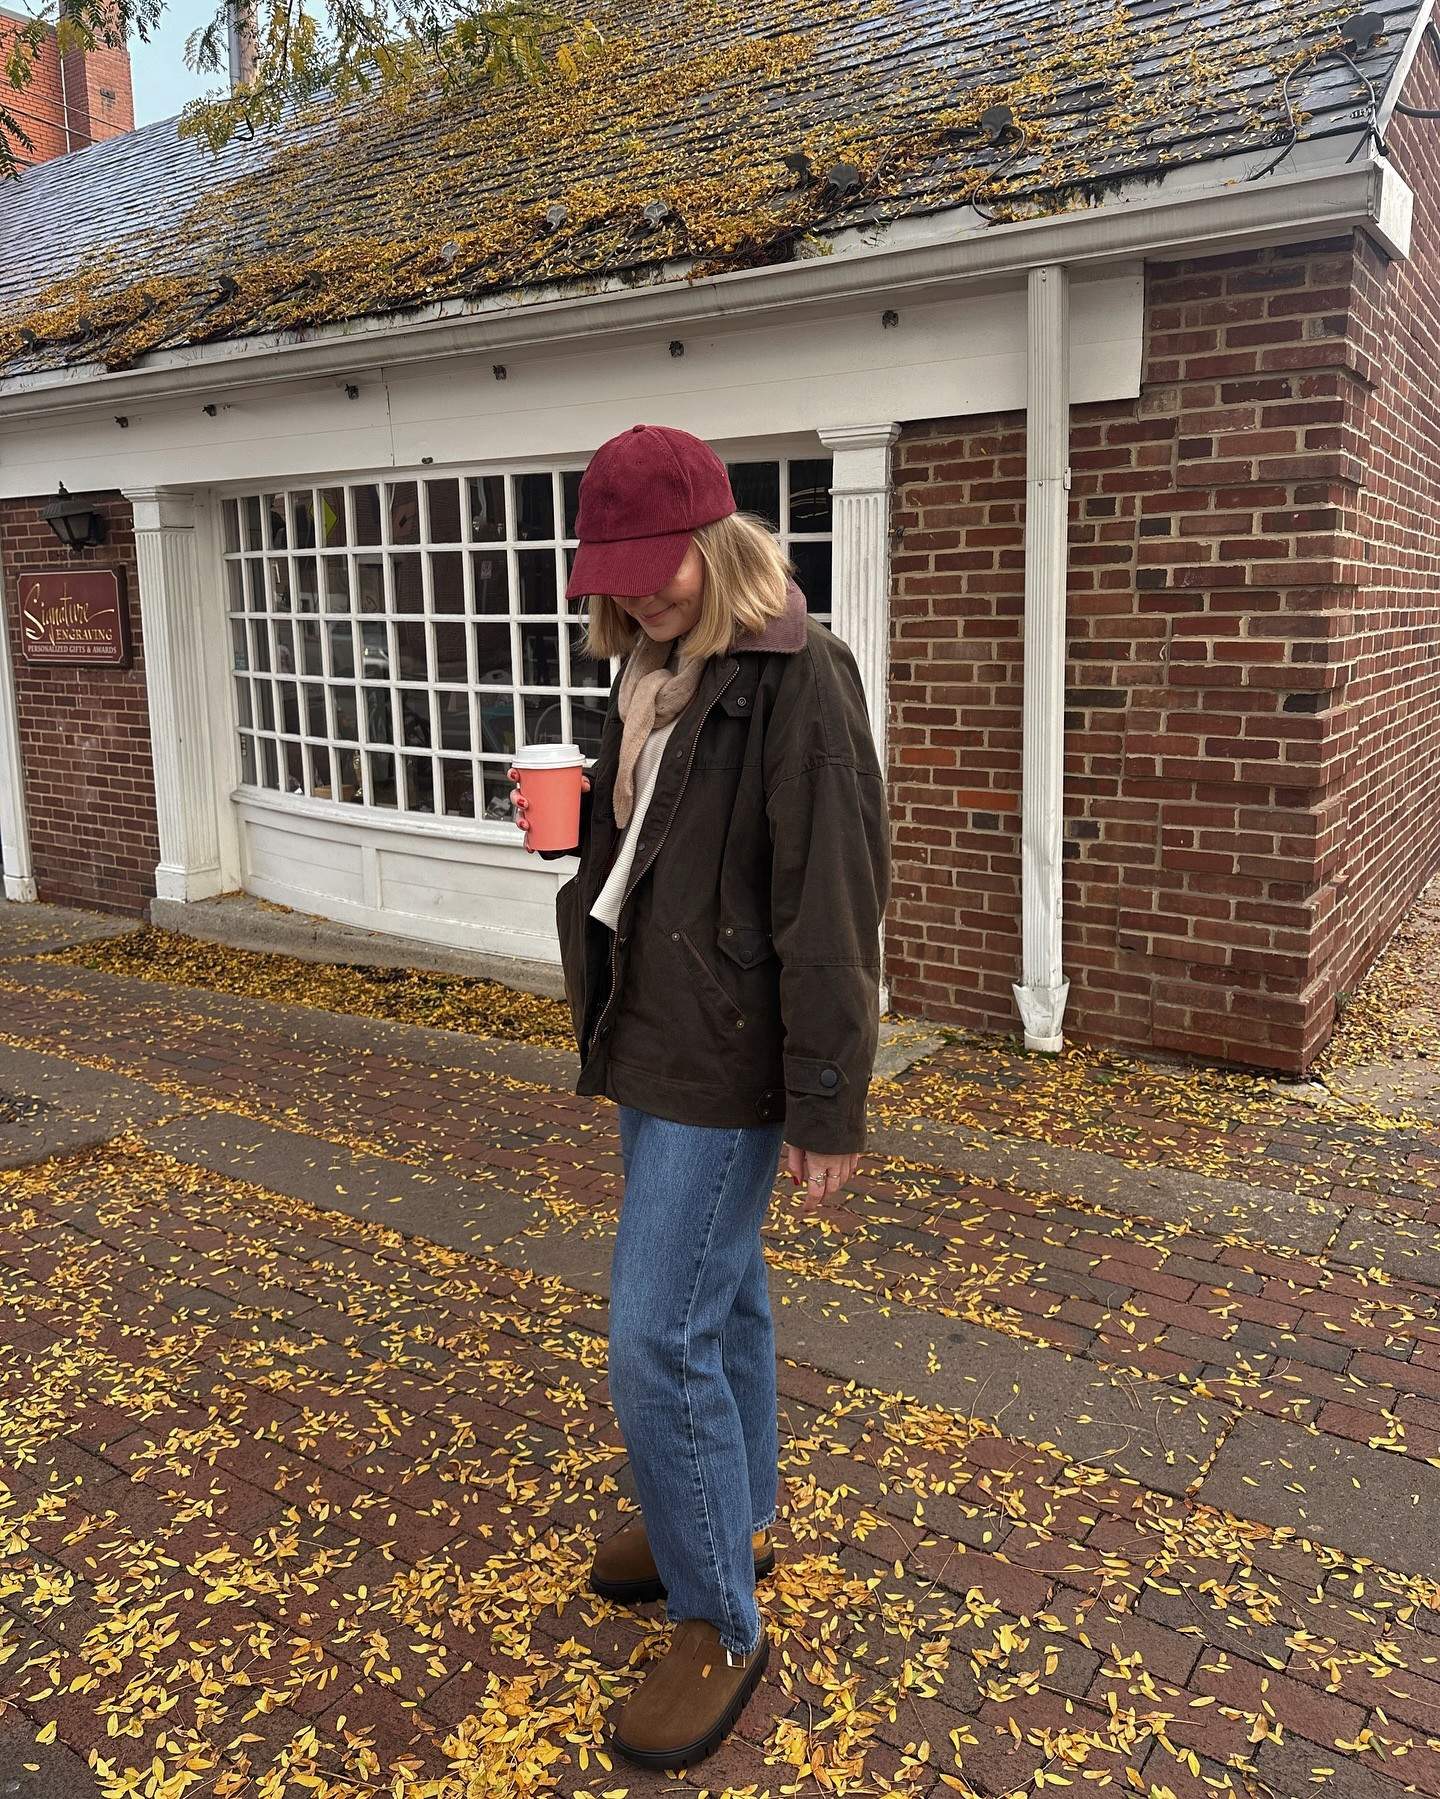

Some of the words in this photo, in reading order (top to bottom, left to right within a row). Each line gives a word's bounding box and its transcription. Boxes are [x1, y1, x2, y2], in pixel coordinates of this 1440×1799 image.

[24, 582, 115, 646] Signature
[56, 629, 113, 640] ENGRAVING
[28, 645, 68, 653] PERSONALIZED
[69, 645, 86, 653] GIFTS
[87, 645, 91, 653] &
[92, 645, 117, 654] AWARDS
